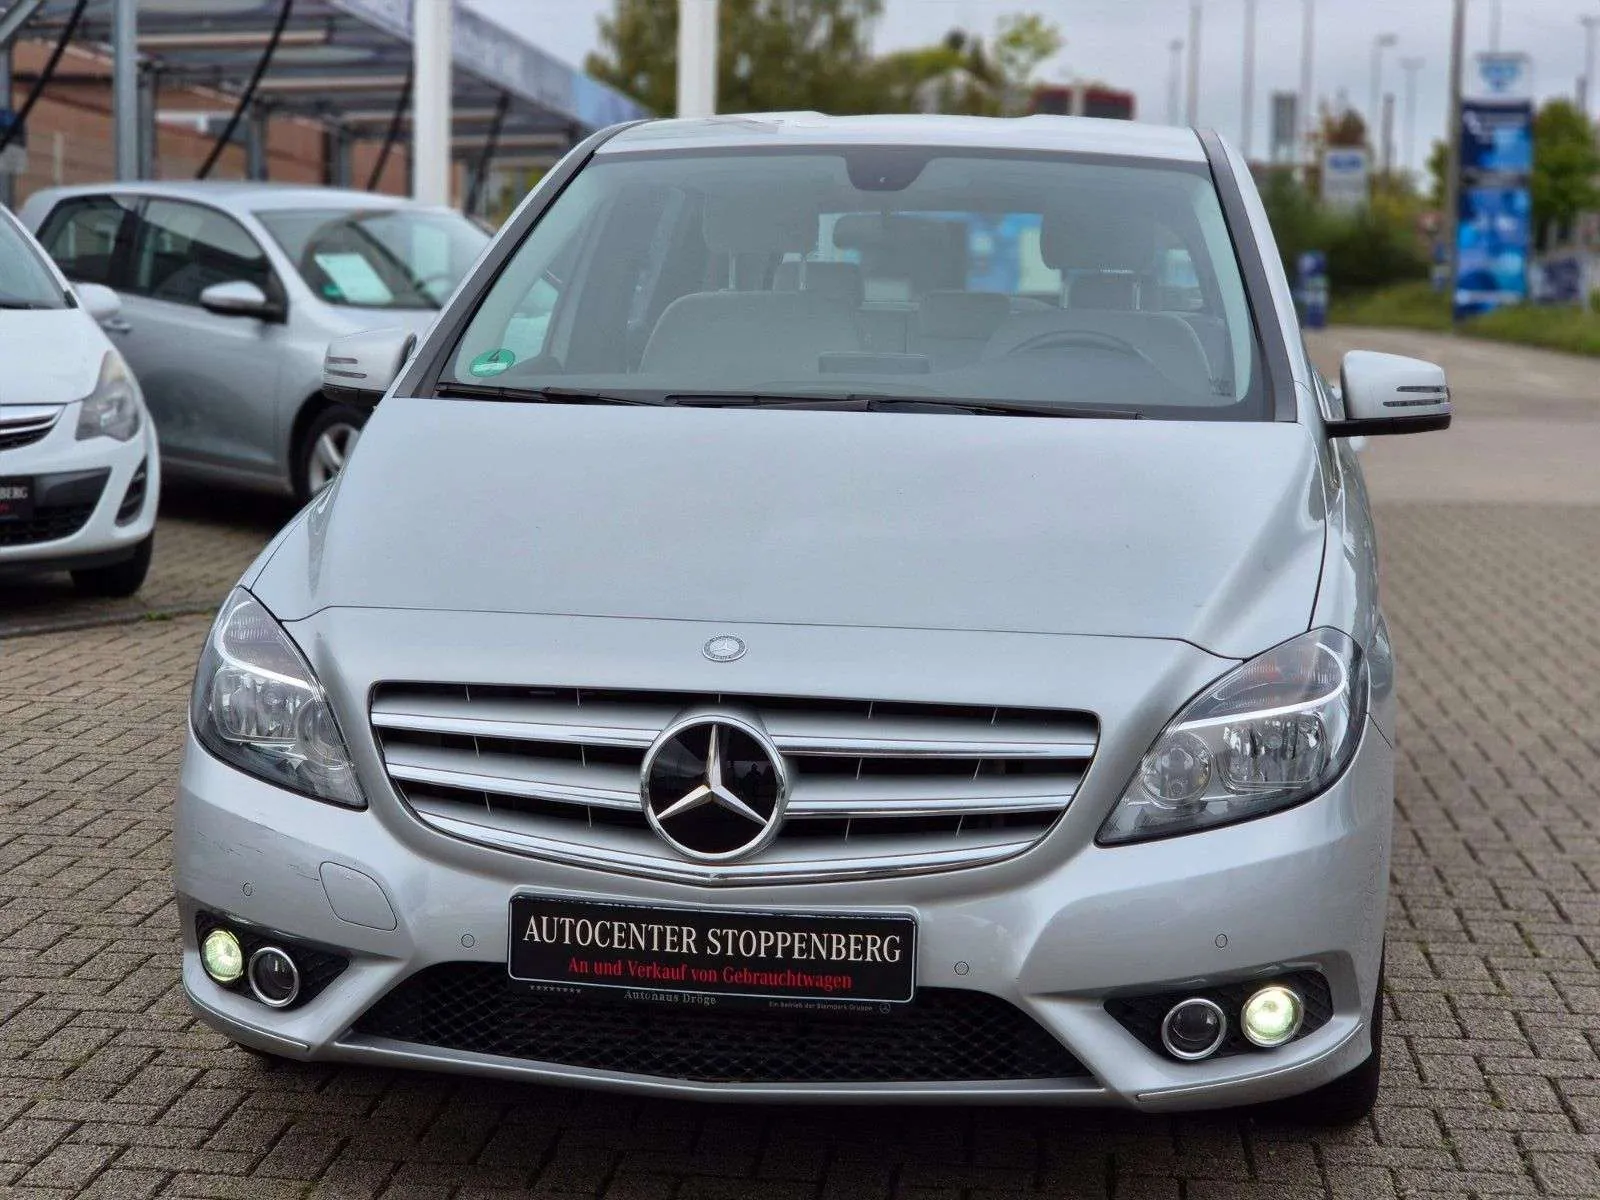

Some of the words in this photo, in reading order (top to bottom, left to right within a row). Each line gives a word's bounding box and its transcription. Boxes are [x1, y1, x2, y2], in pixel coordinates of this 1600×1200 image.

[523, 915, 698, 954] AUTOCENTER
[706, 928, 901, 962] STOPPENBERG
[568, 957, 588, 974] An
[593, 960, 622, 976] und
[628, 960, 688, 981] Verkauf
[692, 967, 717, 983] von
[723, 966, 853, 991] Gebrauchtwagen
[624, 989, 680, 1001] Autohaus
[683, 993, 717, 1006] Dröge
